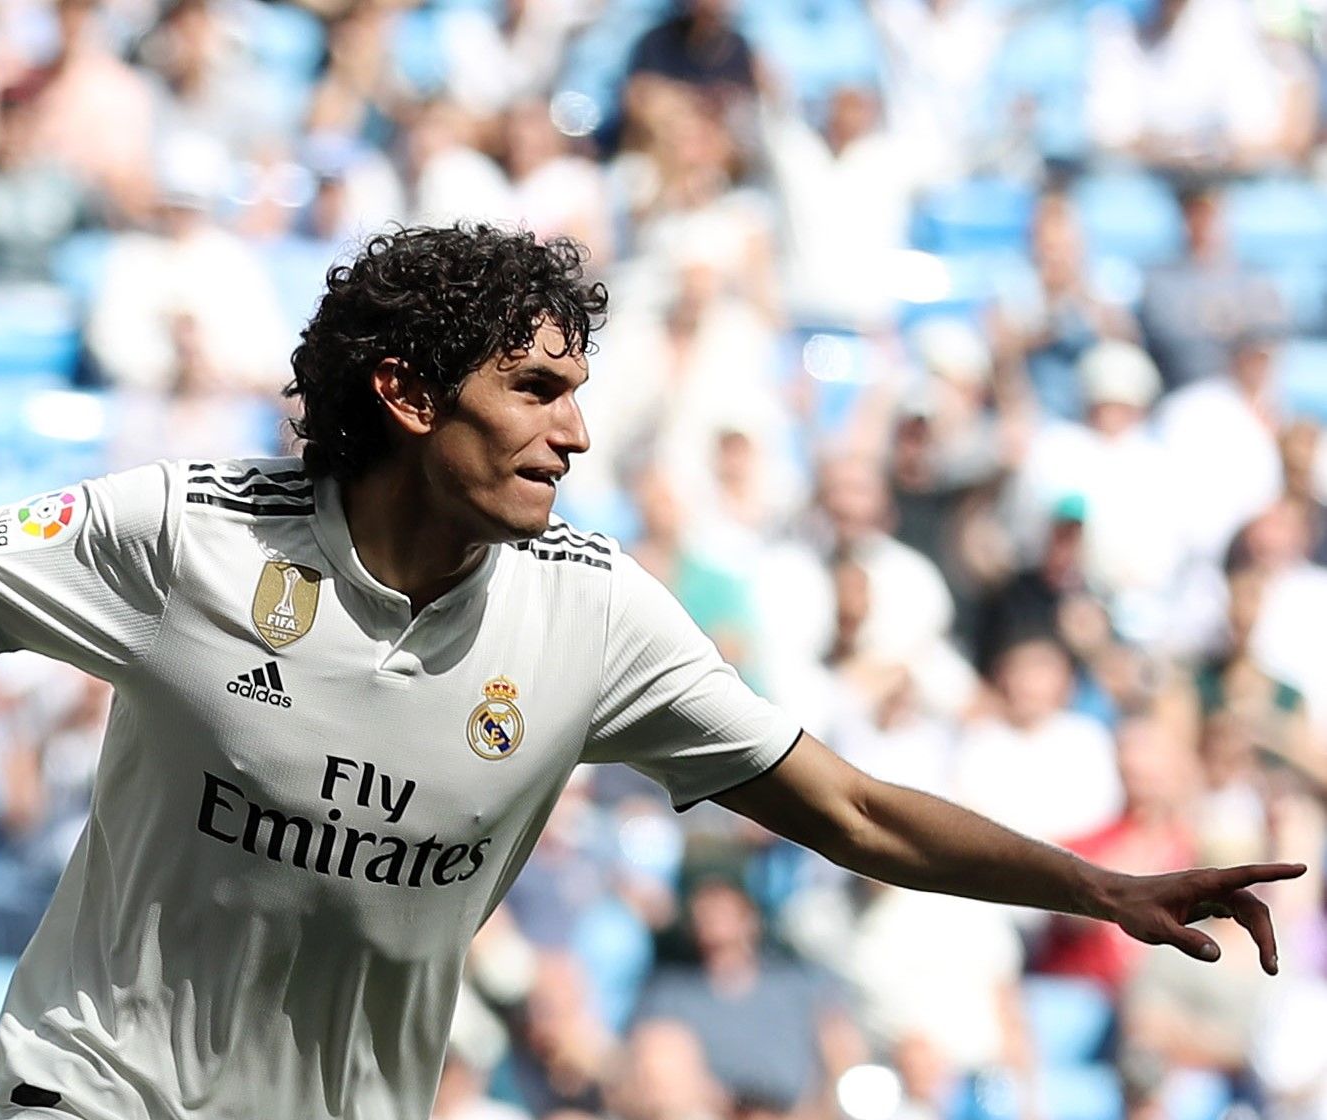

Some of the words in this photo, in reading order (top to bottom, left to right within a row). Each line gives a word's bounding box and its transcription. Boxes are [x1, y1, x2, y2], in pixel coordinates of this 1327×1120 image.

[266, 613, 296, 631] FIFA
[226, 680, 292, 708] adidas
[321, 755, 415, 822] Fly
[198, 771, 491, 887] Emirates
